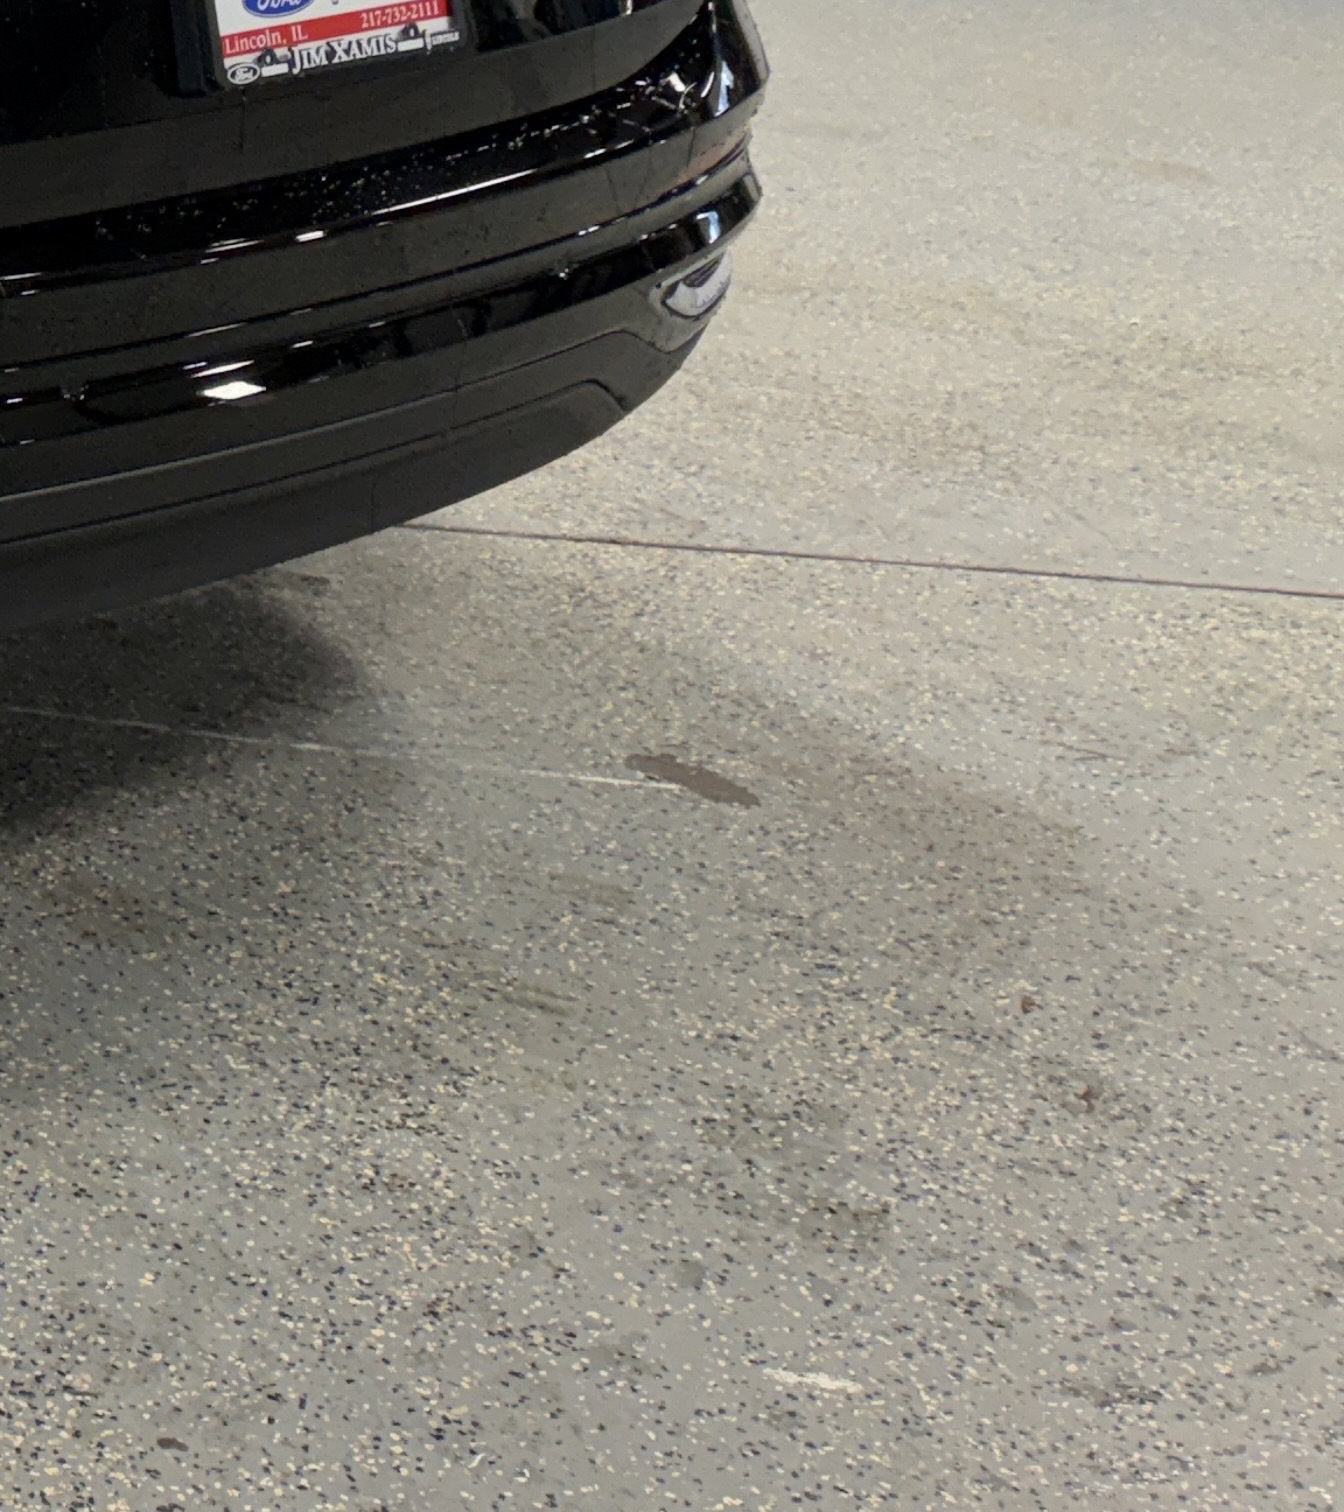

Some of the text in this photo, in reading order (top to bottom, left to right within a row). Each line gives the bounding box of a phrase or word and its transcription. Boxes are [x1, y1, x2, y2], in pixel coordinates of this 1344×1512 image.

[361, 0, 440, 28] 217-732-2111
[290, 24, 309, 42] IL
[291, 45, 329, 75] JIM
[331, 34, 397, 64] XAMIS
